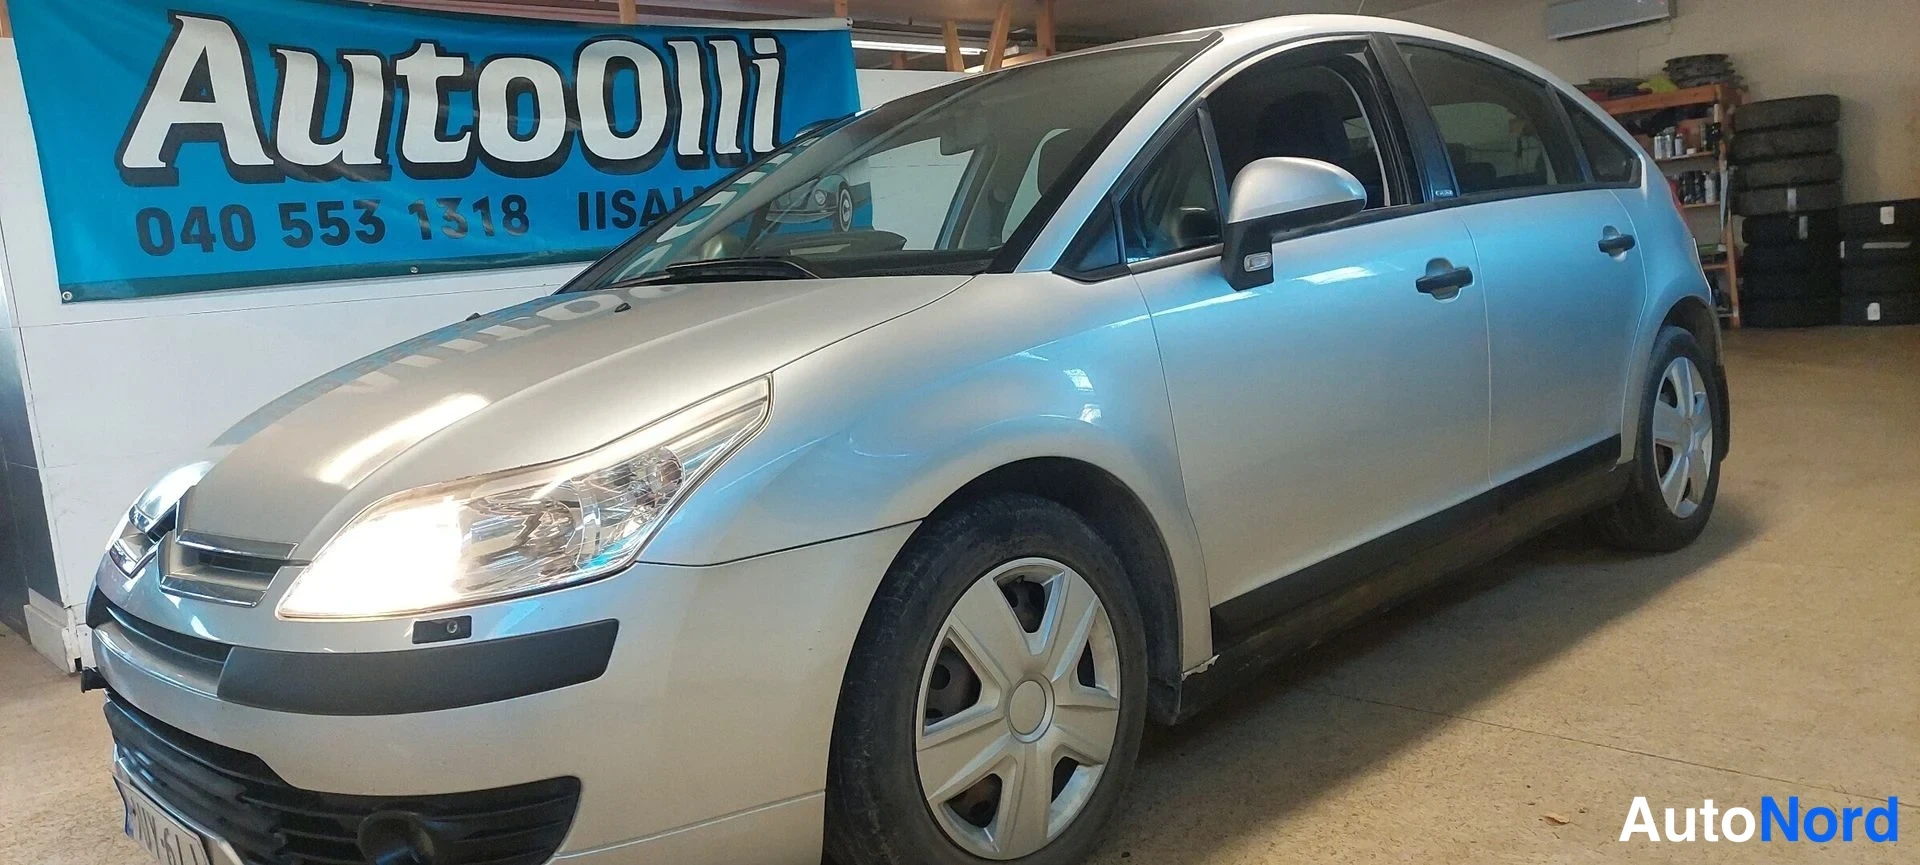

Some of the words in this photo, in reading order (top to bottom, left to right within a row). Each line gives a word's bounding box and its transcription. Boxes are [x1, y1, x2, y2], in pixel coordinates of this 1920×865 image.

[116, 11, 785, 186] AutoOlli
[135, 204, 257, 257] 040
[278, 200, 387, 249] 553
[408, 194, 530, 240] 1318
[578, 186, 707, 231] IISA
